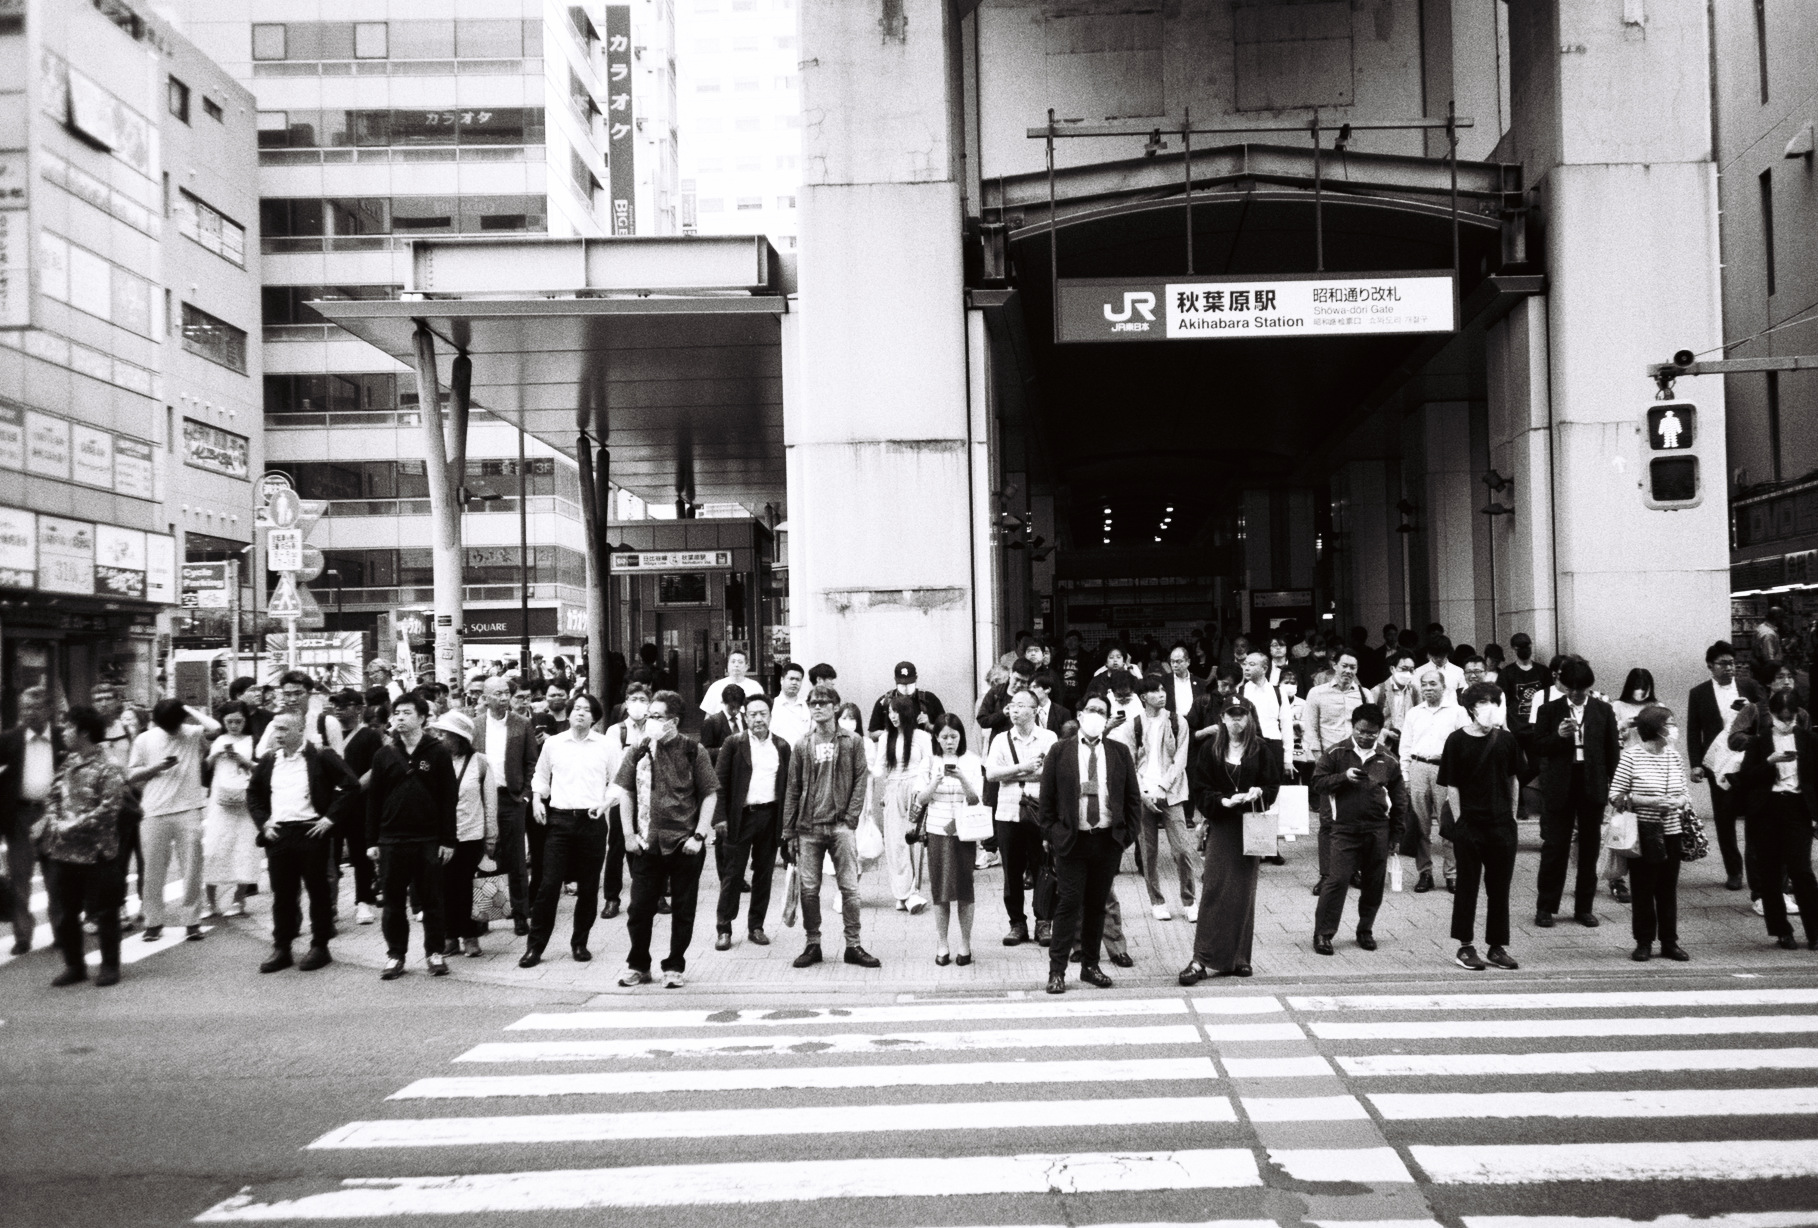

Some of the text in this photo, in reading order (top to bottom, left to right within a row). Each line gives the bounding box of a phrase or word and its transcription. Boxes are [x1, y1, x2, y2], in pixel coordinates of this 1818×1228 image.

[609, 34, 630, 140] カラオケ
[425, 110, 493, 125] カラオケ
[1177, 288, 1277, 314] 秋葉原駅
[1313, 285, 1402, 304] 昭和通り改札
[1103, 291, 1157, 322] JR
[1370, 303, 1395, 314] Gate
[1111, 321, 1151, 333] JR東日本
[1178, 315, 1305, 330] Akihabara Station
[535, 461, 553, 474] 3F
[182, 568, 213, 578] Cycle
[182, 578, 224, 589] Parking
[471, 622, 508, 633] SQUARE
